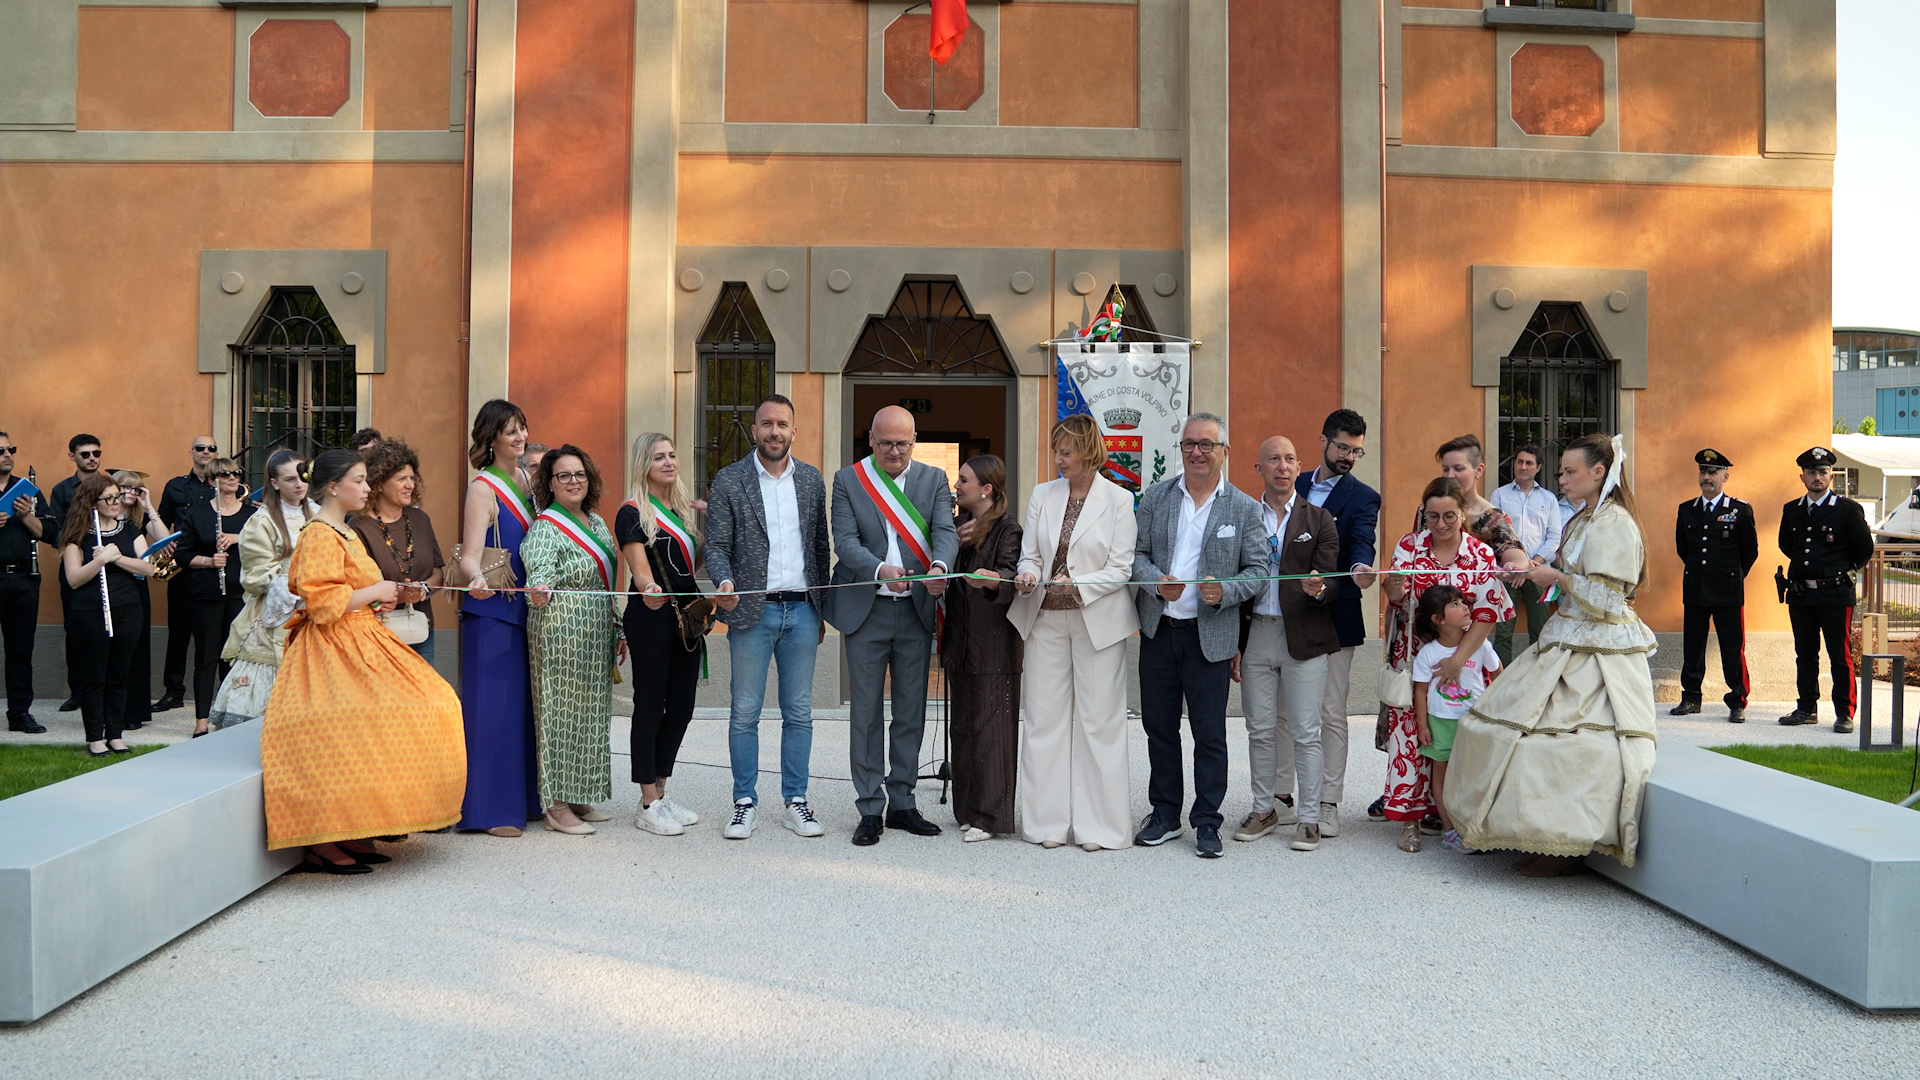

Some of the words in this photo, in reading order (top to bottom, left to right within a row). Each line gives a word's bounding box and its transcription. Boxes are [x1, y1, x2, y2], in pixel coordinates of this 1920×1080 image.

[1078, 390, 1107, 416] COMUNE
[1107, 388, 1116, 397] DI
[1116, 386, 1140, 397] COSTA
[1141, 391, 1168, 417] VOLPINO
